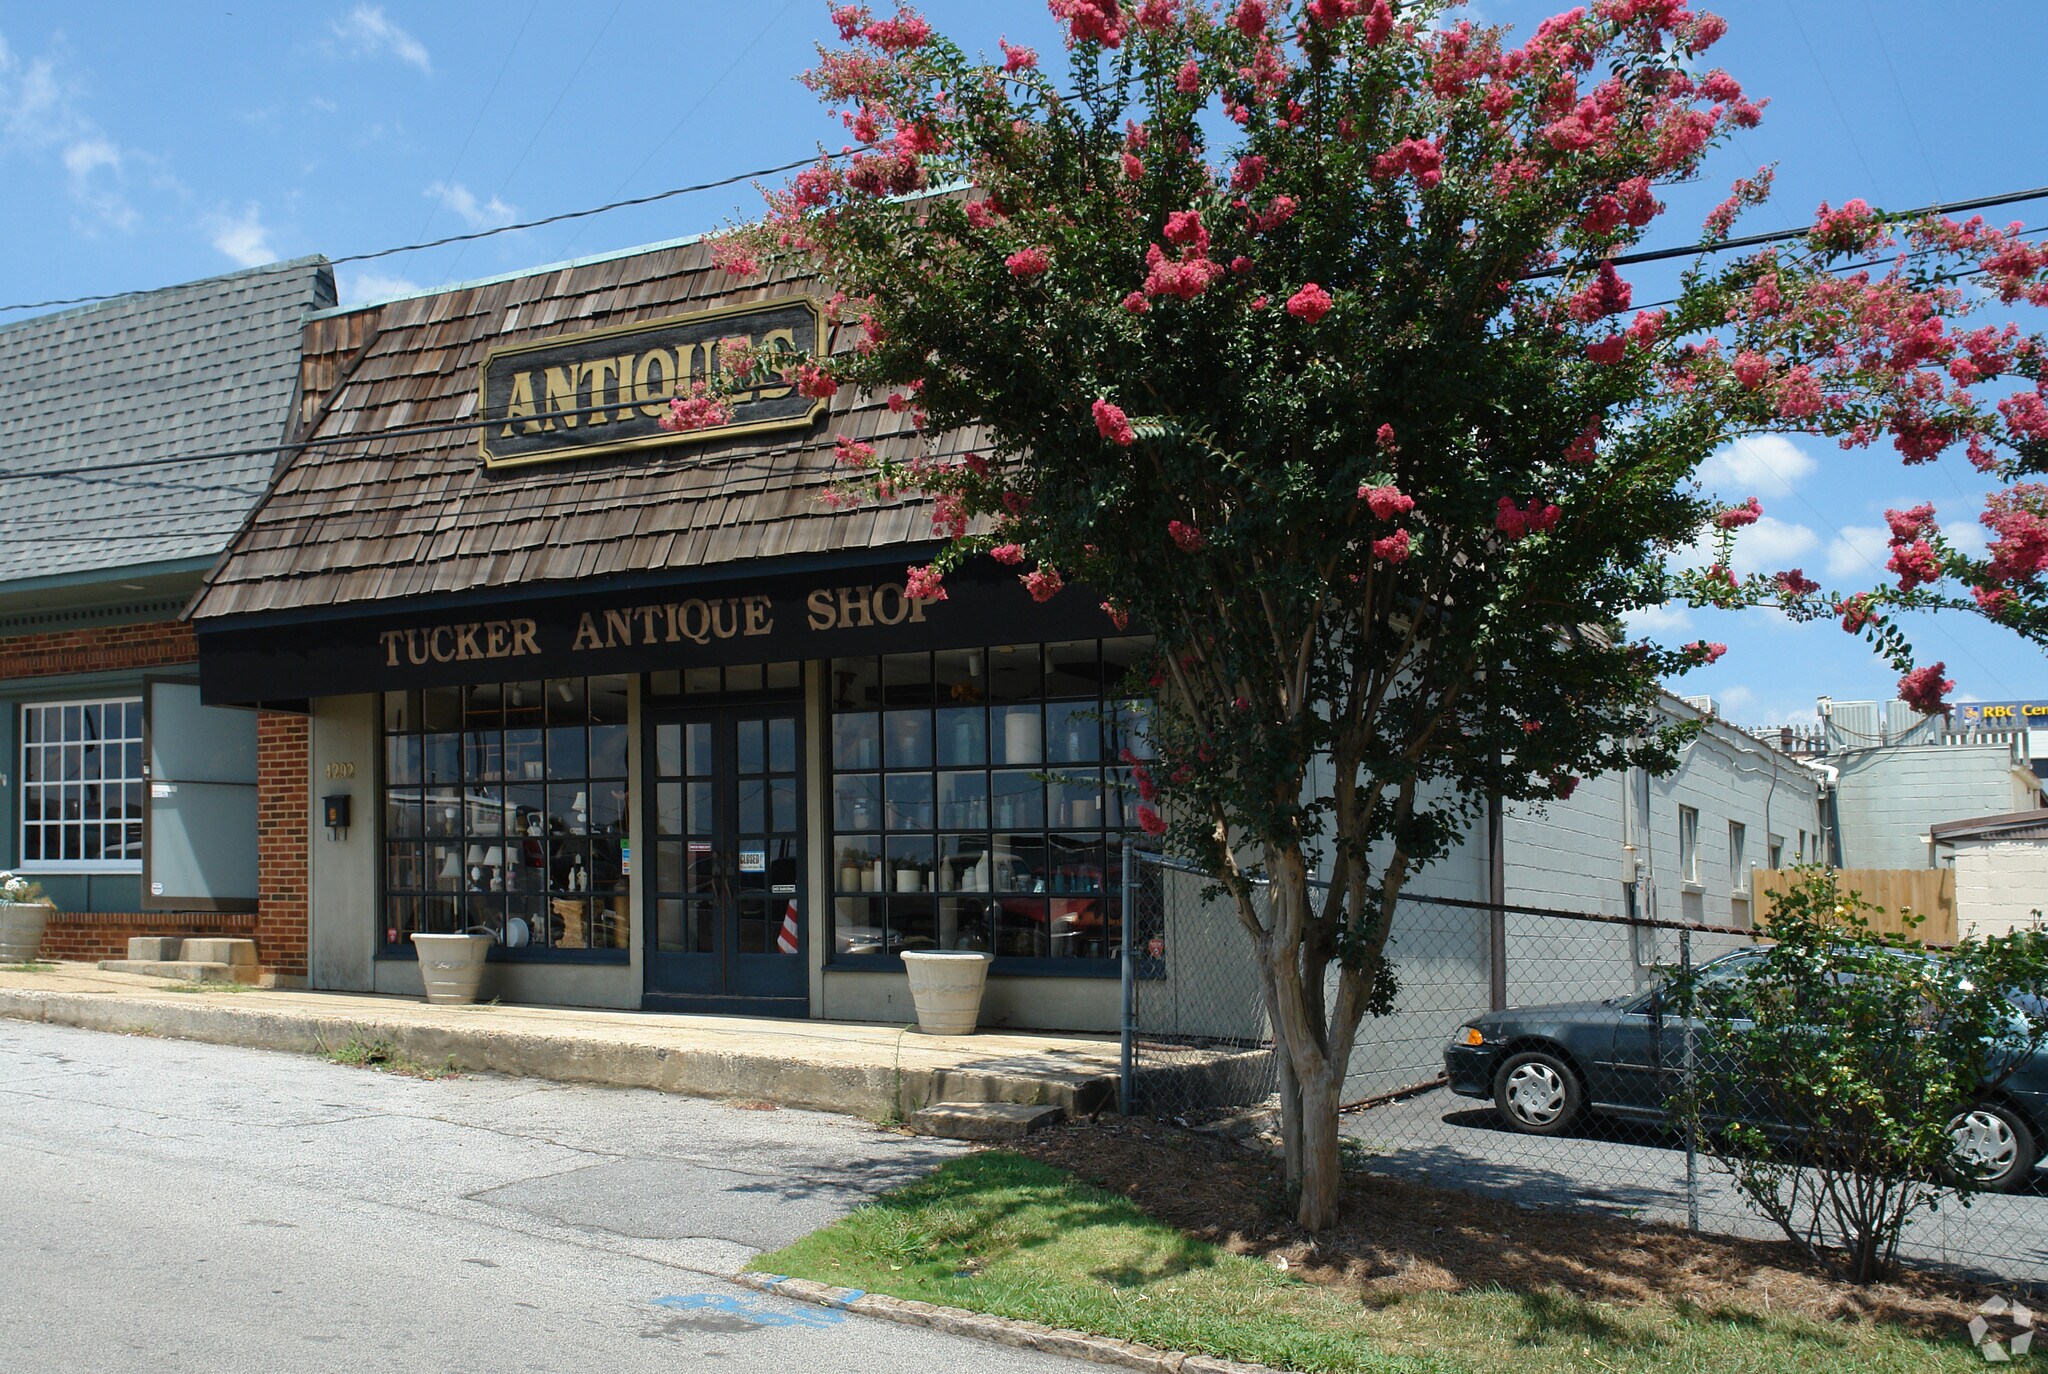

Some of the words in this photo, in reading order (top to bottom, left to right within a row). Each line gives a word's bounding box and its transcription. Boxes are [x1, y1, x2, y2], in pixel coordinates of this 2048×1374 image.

[379, 618, 542, 666] TUCKER
[572, 595, 774, 650] ANTIQUE
[807, 577, 940, 631] SHOP
[1983, 705, 2017, 717] RBC
[740, 854, 760, 864] CLOSED
